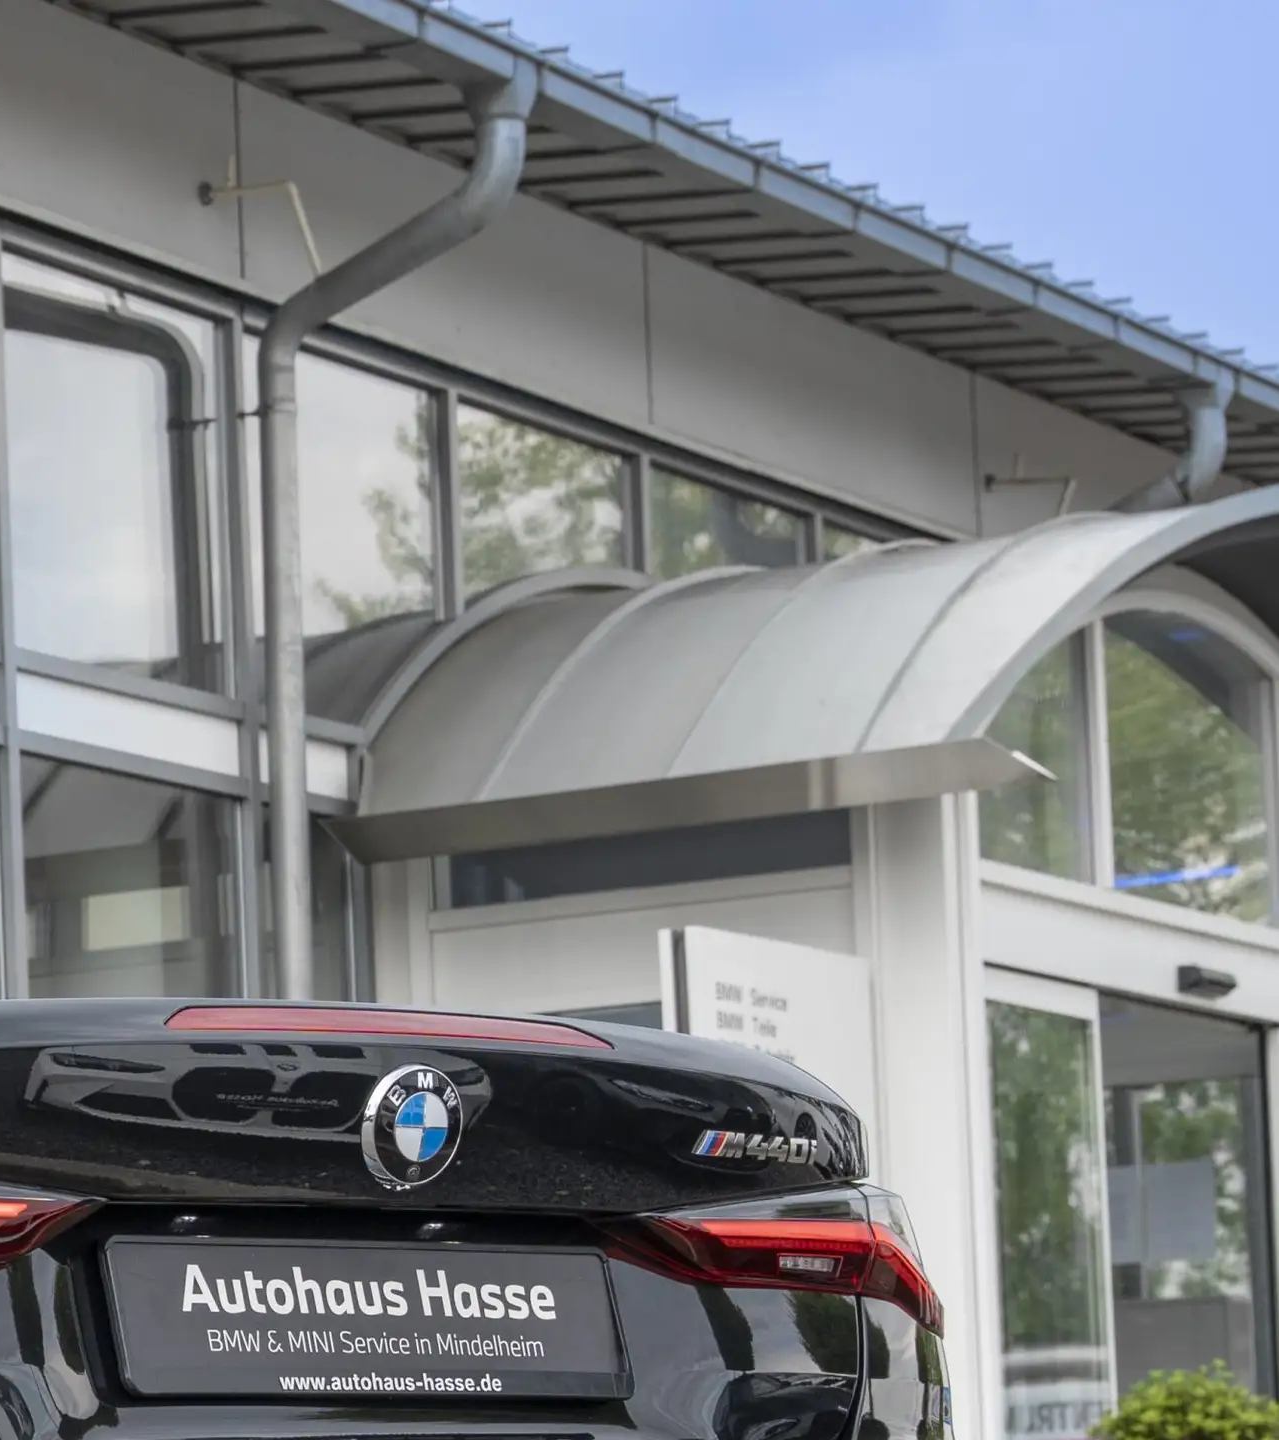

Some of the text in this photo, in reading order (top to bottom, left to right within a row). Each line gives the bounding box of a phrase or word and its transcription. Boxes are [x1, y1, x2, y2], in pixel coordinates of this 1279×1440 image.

[386, 1071, 458, 1110] BMW
[722, 1131, 818, 1165] M440i
[182, 1263, 557, 1321] Autohaus Hasse
[206, 1328, 545, 1358] BMW & MINI Service in Mindelheim
[279, 1371, 503, 1393] www.autohaus-hasse.de
